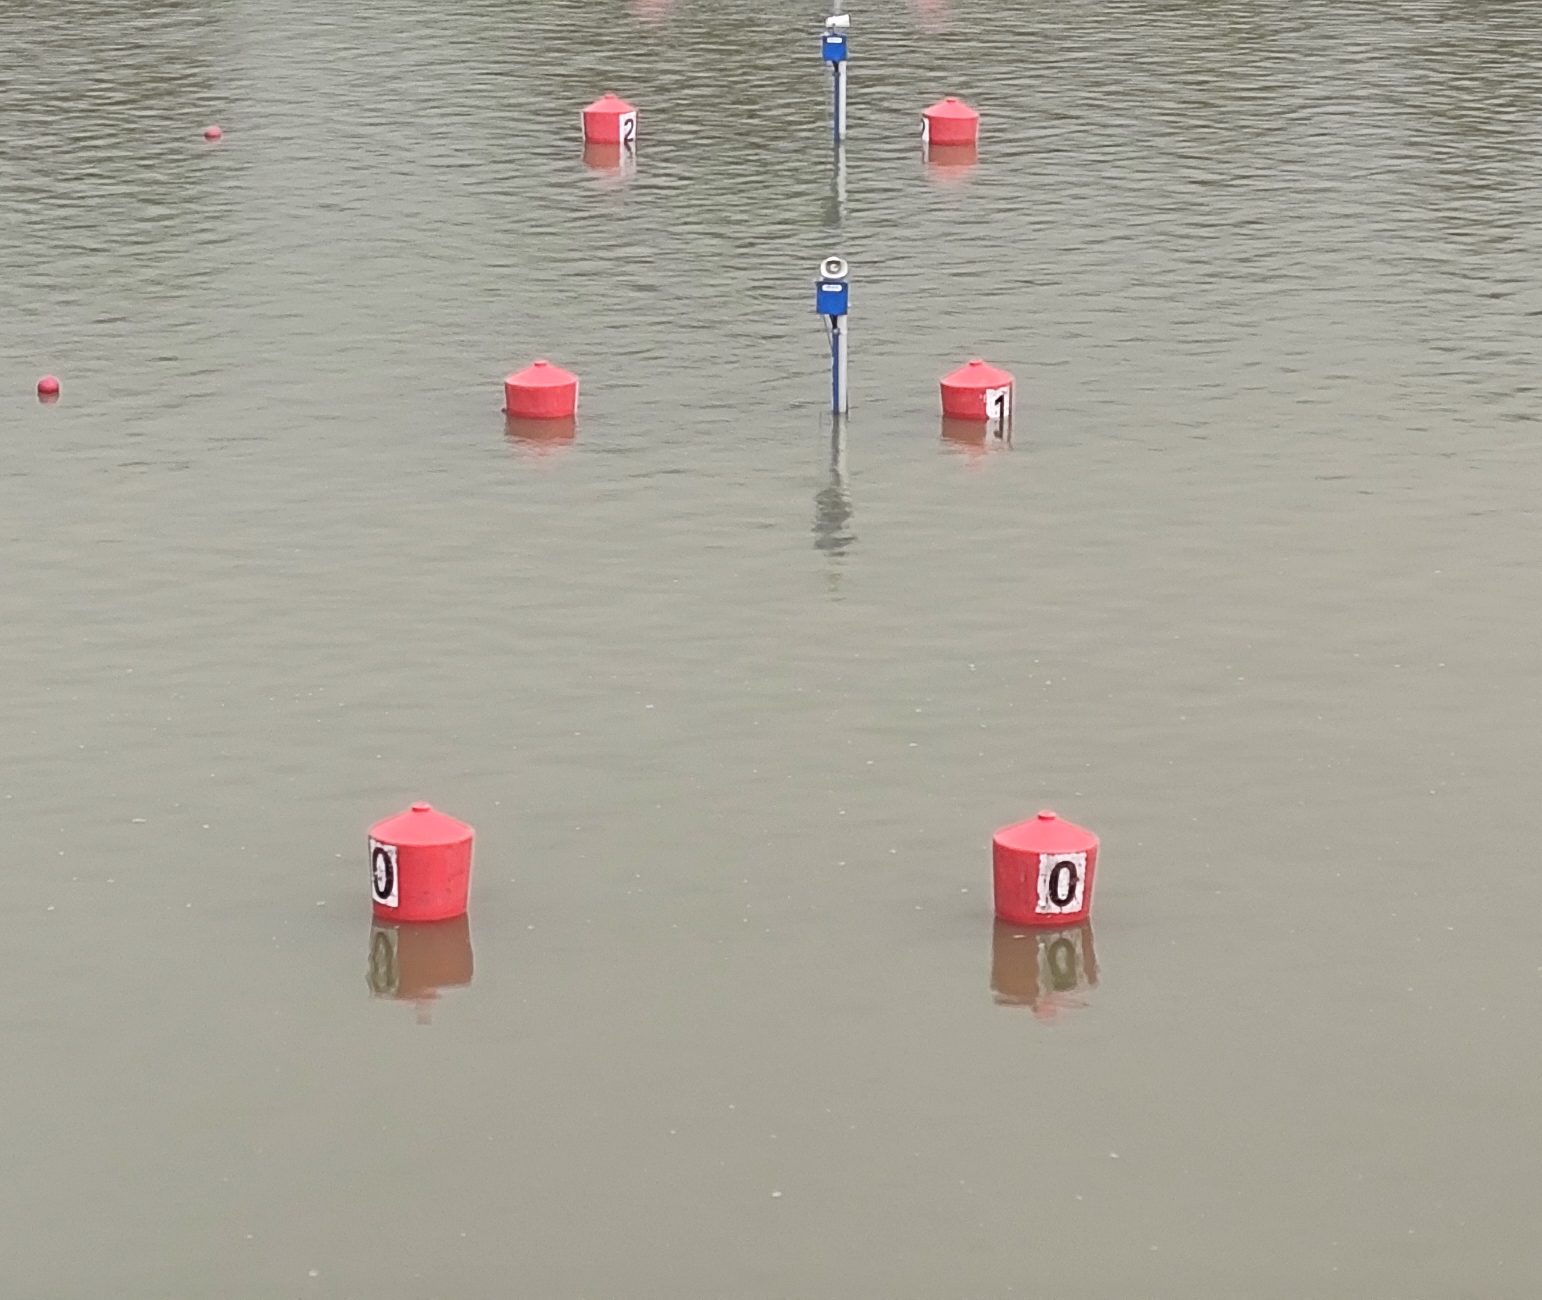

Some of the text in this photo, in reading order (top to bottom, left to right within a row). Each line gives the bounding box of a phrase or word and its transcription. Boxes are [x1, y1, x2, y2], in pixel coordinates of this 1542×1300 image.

[623, 118, 634, 141] 2
[994, 394, 1005, 419] 1
[372, 846, 395, 900] 0
[1048, 860, 1079, 907] 0
